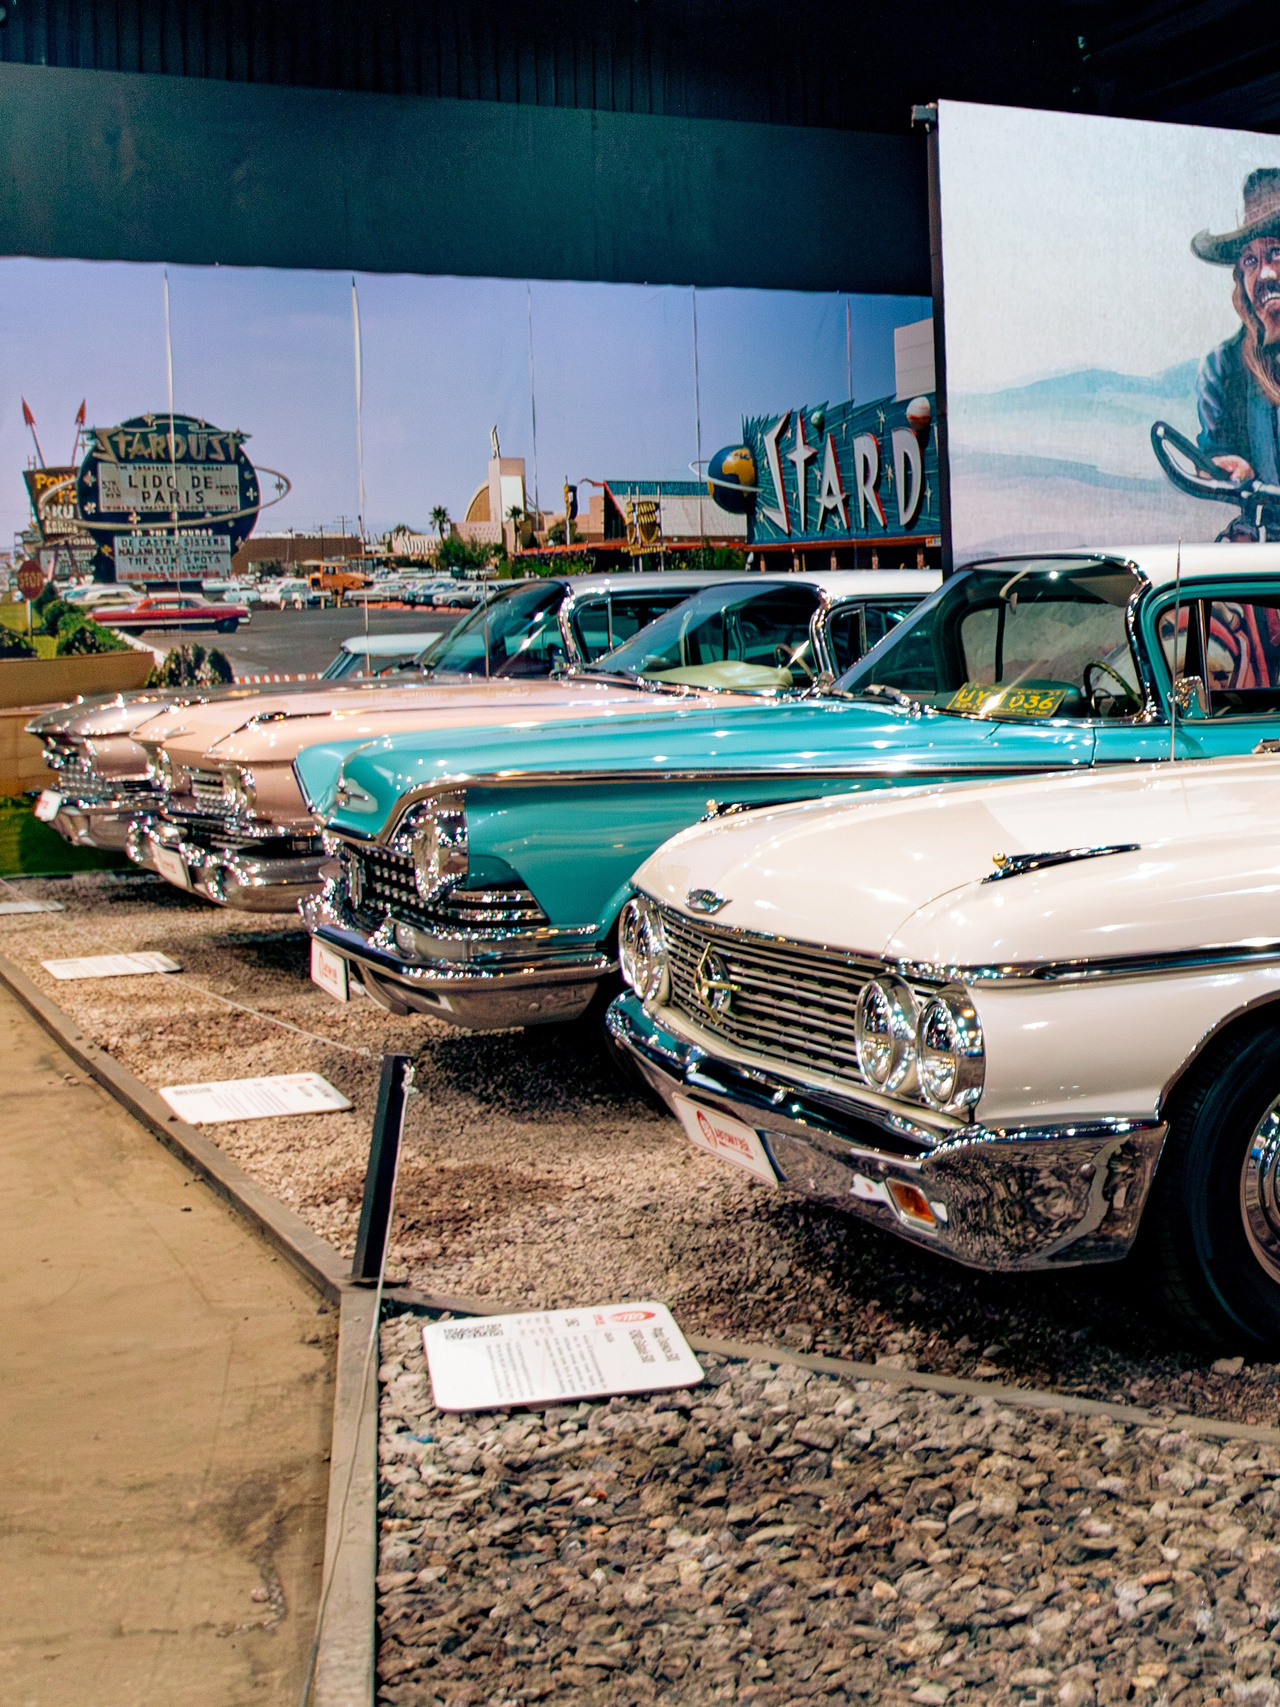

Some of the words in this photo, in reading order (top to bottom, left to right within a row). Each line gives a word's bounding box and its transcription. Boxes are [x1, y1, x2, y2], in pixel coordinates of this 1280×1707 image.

[93, 427, 239, 463] STARDUST
[128, 474, 177, 489] LIDO
[191, 474, 213, 489] DE
[142, 490, 204, 504] PARIS
[129, 557, 148, 565] THE
